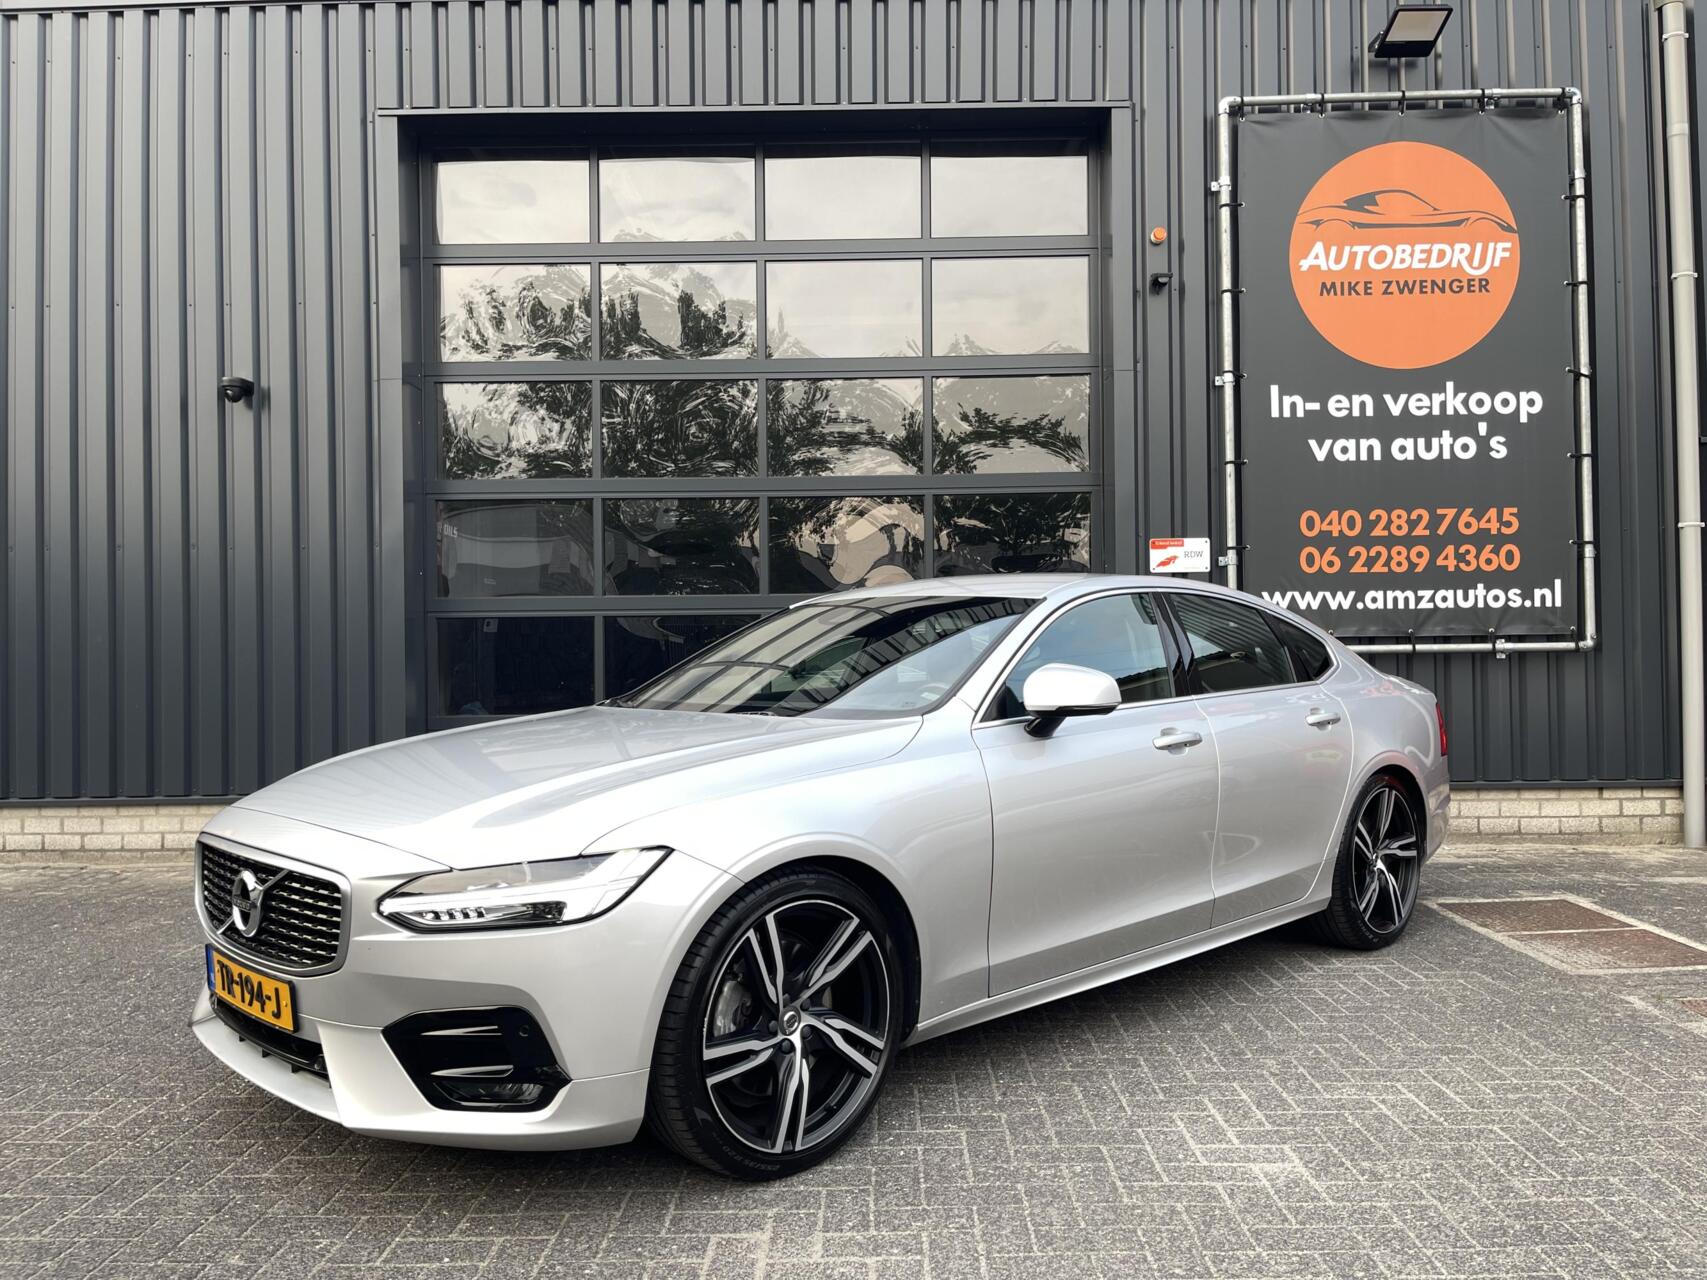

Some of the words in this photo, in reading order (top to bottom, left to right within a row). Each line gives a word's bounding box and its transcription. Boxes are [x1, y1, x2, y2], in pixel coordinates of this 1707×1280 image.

[1299, 241, 1511, 276] AUTOBEDRIJF
[1319, 281, 1373, 296] MIKE
[1382, 278, 1490, 295] ZWENGER
[1270, 385, 1321, 418] In-
[1328, 393, 1374, 418] en
[1383, 381, 1544, 423] verkoop
[1308, 438, 1382, 462] van
[1391, 422, 1508, 461] auto's
[1300, 510, 1362, 537] 040
[1369, 508, 1430, 536] 282
[1436, 507, 1519, 535] 7645
[1184, 550, 1204, 558] RDW
[1300, 546, 1341, 574] 06
[1348, 545, 1430, 573] 2289
[1436, 544, 1521, 572] 4360
[1261, 579, 1562, 610] www.amzautos.nl
[217, 959, 281, 1019] TR-194-J
